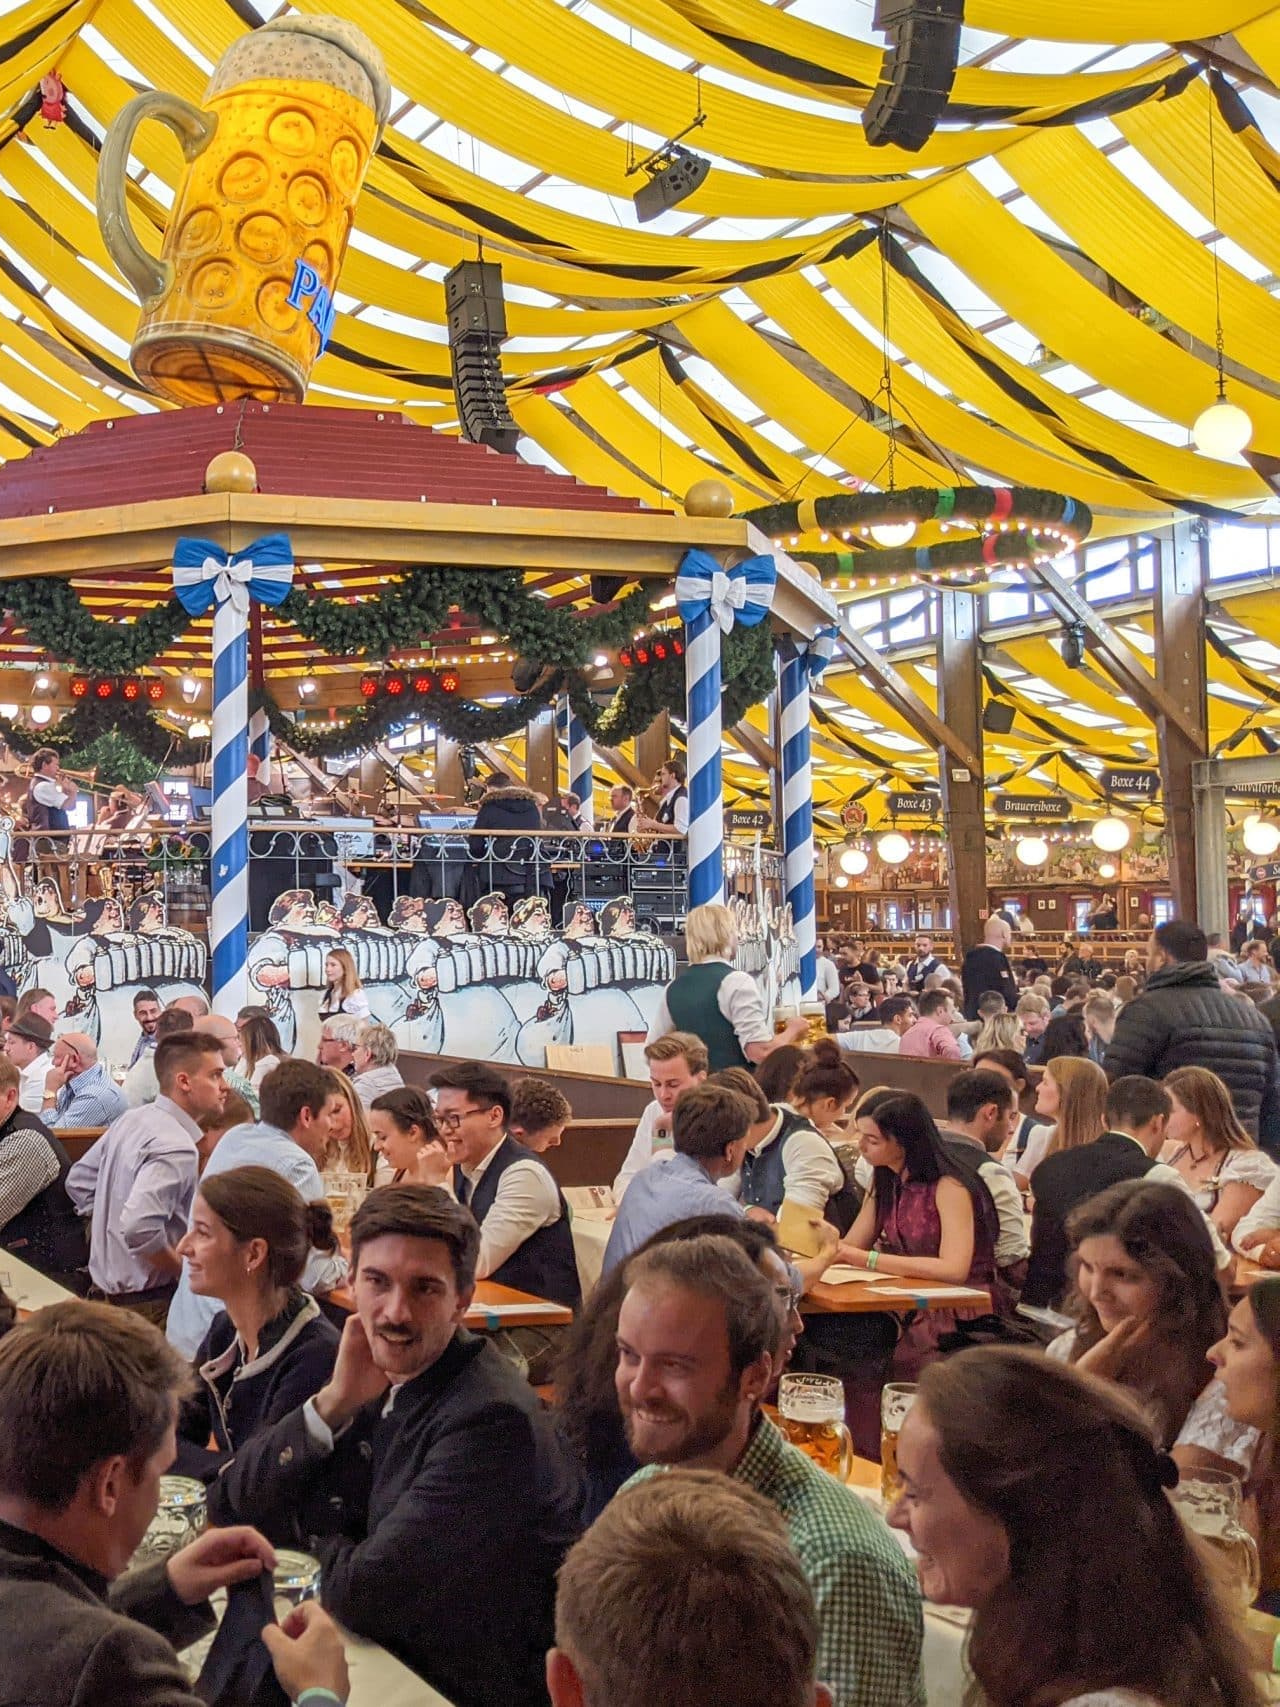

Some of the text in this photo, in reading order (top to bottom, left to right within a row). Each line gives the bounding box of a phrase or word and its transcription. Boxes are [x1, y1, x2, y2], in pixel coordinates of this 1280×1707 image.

[1110, 775, 1151, 790] Boxe 44
[897, 797, 932, 812] Boxe 43
[1004, 800, 1061, 813] Brauereiboxe
[732, 814, 764, 826] Boxe 42
